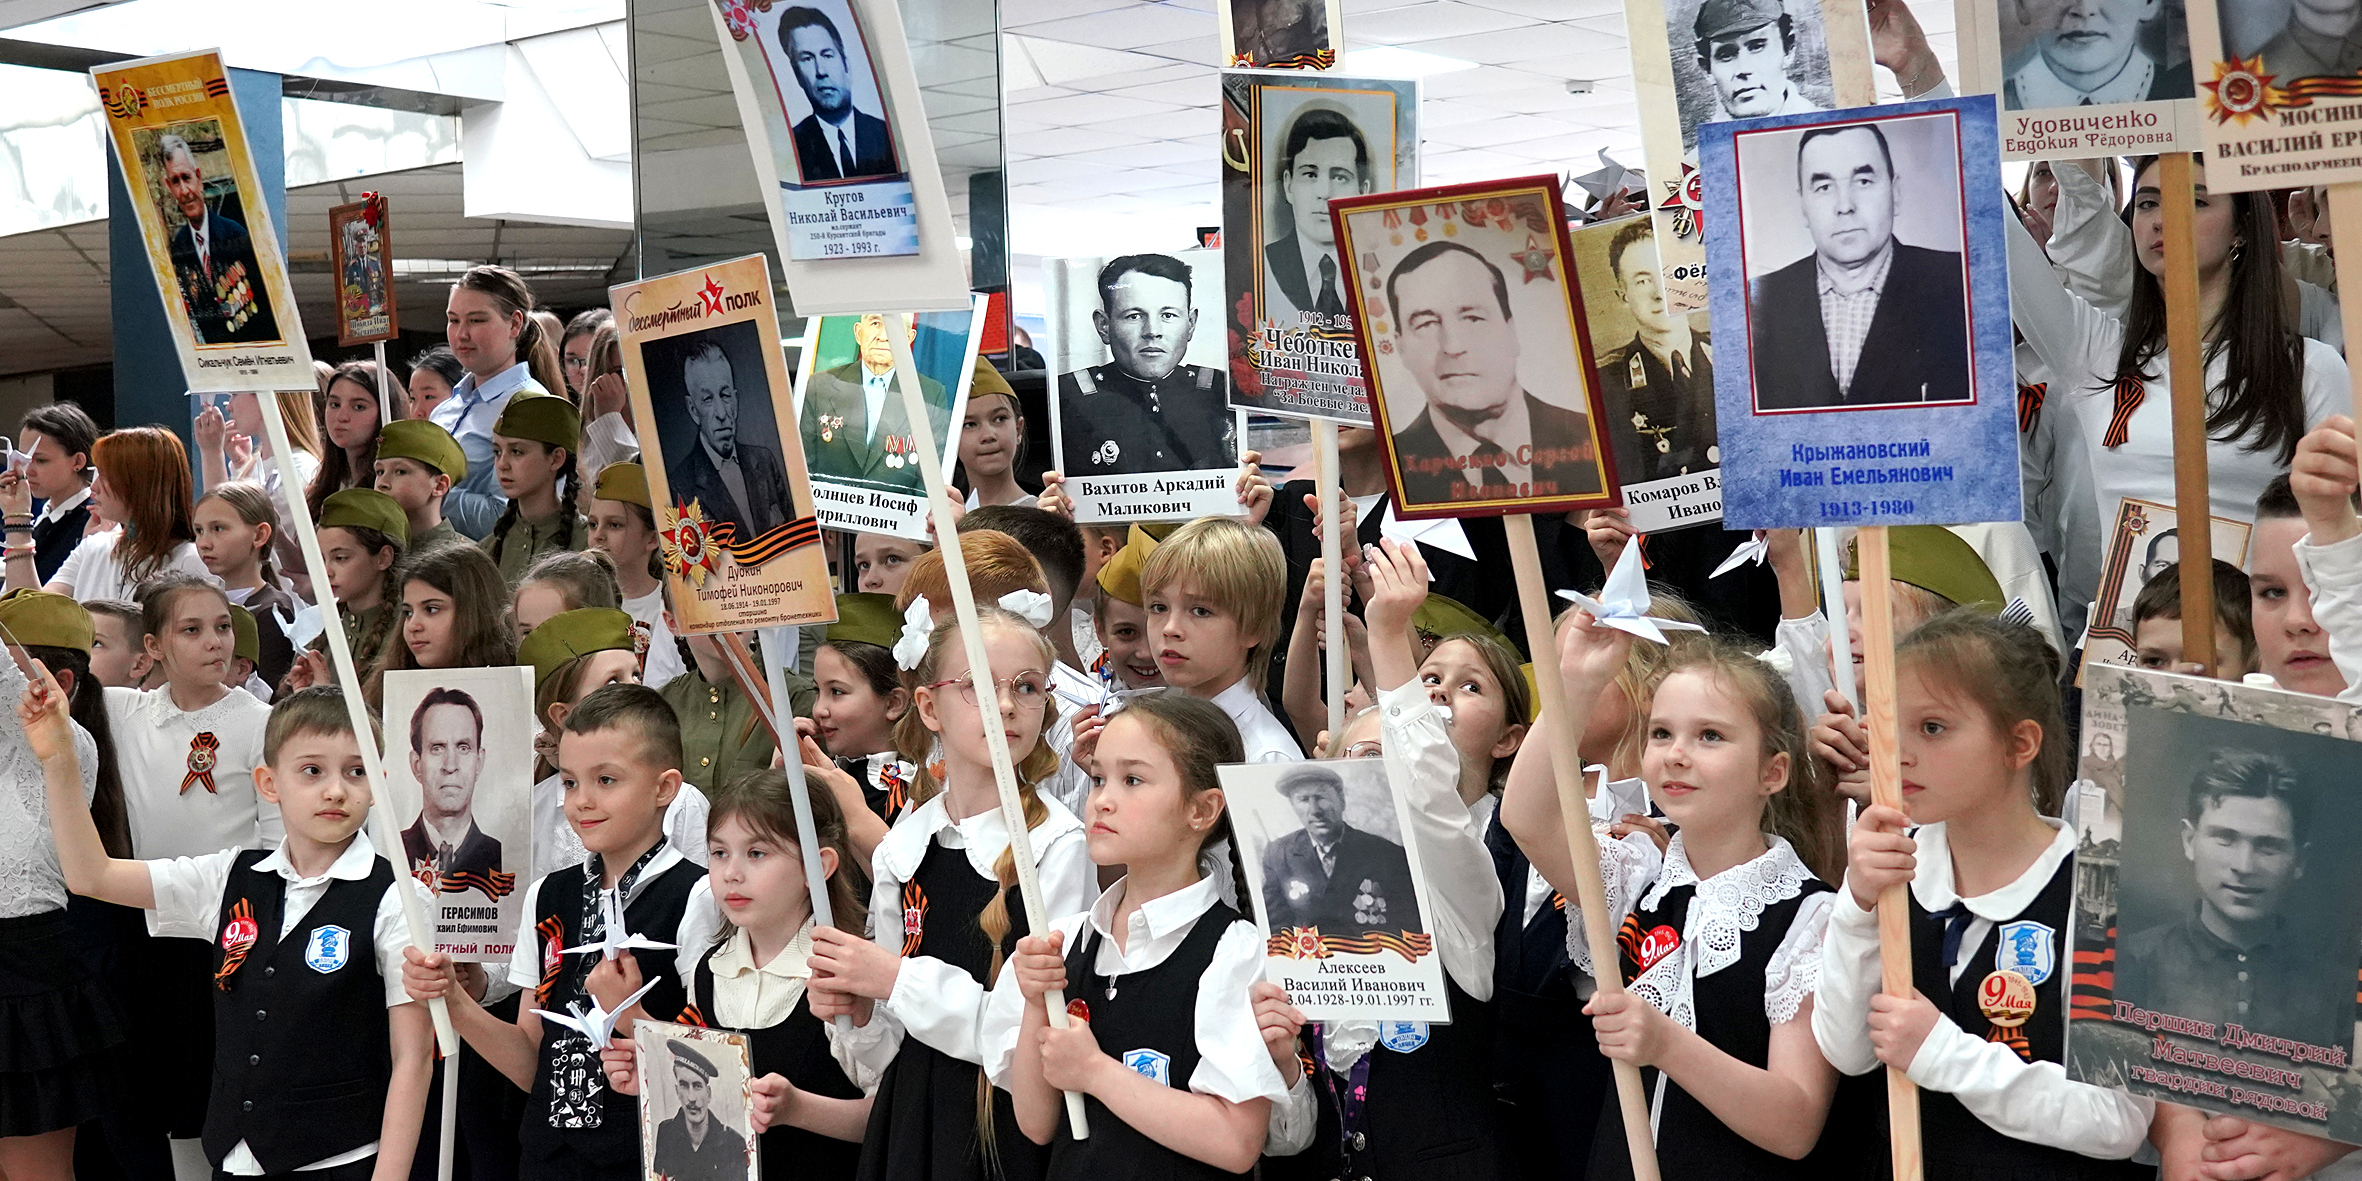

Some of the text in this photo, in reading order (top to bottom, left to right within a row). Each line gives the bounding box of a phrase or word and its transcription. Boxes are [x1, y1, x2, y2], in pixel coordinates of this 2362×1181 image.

[146, 78, 204, 97] БЕССМЕРТНЫЙ
[153, 92, 206, 109] ПОЛК РОССИИ
[2016, 110, 2158, 138] Удовиченко
[2279, 105, 2362, 127] МОСИН
[2006, 131, 2173, 154] Евдокия Фёдоровна
[2217, 131, 2362, 158] ВАСИЛИЙ ЕР
[824, 191, 865, 207] Кругов
[789, 206, 908, 225] Николай Васильевич
[862, 230, 886, 238] бригады
[824, 244, 844, 255] 1923
[852, 242, 872, 254] 1993
[874, 245, 881, 253] г.
[725, 290, 762, 312] ПОЛК
[1299, 311, 1324, 325] 1912
[233, 356, 255, 367] Семён
[255, 355, 295, 366] Игнатьевич
[1259, 350, 1301, 371] Иван
[1261, 372, 1329, 392] Награжден
[1297, 393, 1344, 409] Боевые
[1792, 438, 1930, 465] Крыжановский
[1082, 475, 1226, 496] Вахитов Аркадий
[1780, 465, 1954, 487] Иван Емельянович
[811, 485, 918, 516] олнцев Иосиф
[1627, 483, 1700, 505] Комаров
[814, 505, 898, 531] ириллович
[1098, 502, 1192, 517] Маликович
[1820, 499, 1914, 517] 1913-1980
[696, 580, 803, 602] Тимофей Никонорович
[721, 601, 749, 610] 18.06.1914
[752, 598, 781, 608] 19.01.1997
[689, 621, 715, 630] командир
[716, 618, 746, 627] отделения
[754, 616, 779, 625] ремонту
[780, 611, 822, 621] бронетехники
[441, 907, 498, 919] ГЕРАСИМОВ
[226, 922, 240, 946] 9
[457, 924, 498, 933] Ефимович
[1641, 935, 1656, 967] 9
[1318, 961, 1386, 973] Алексеев
[1284, 978, 1426, 991] Василий Иванович
[1985, 975, 2032, 1009] 9 Мая
[1419, 998, 1435, 1006] гг.
[2113, 1000, 2347, 1068] Першин Дмитрий
[2152, 1038, 2302, 1089] Матвеевич
[569, 1068, 586, 1088] HP
[2131, 1065, 2328, 1120] гвардии рядовой
